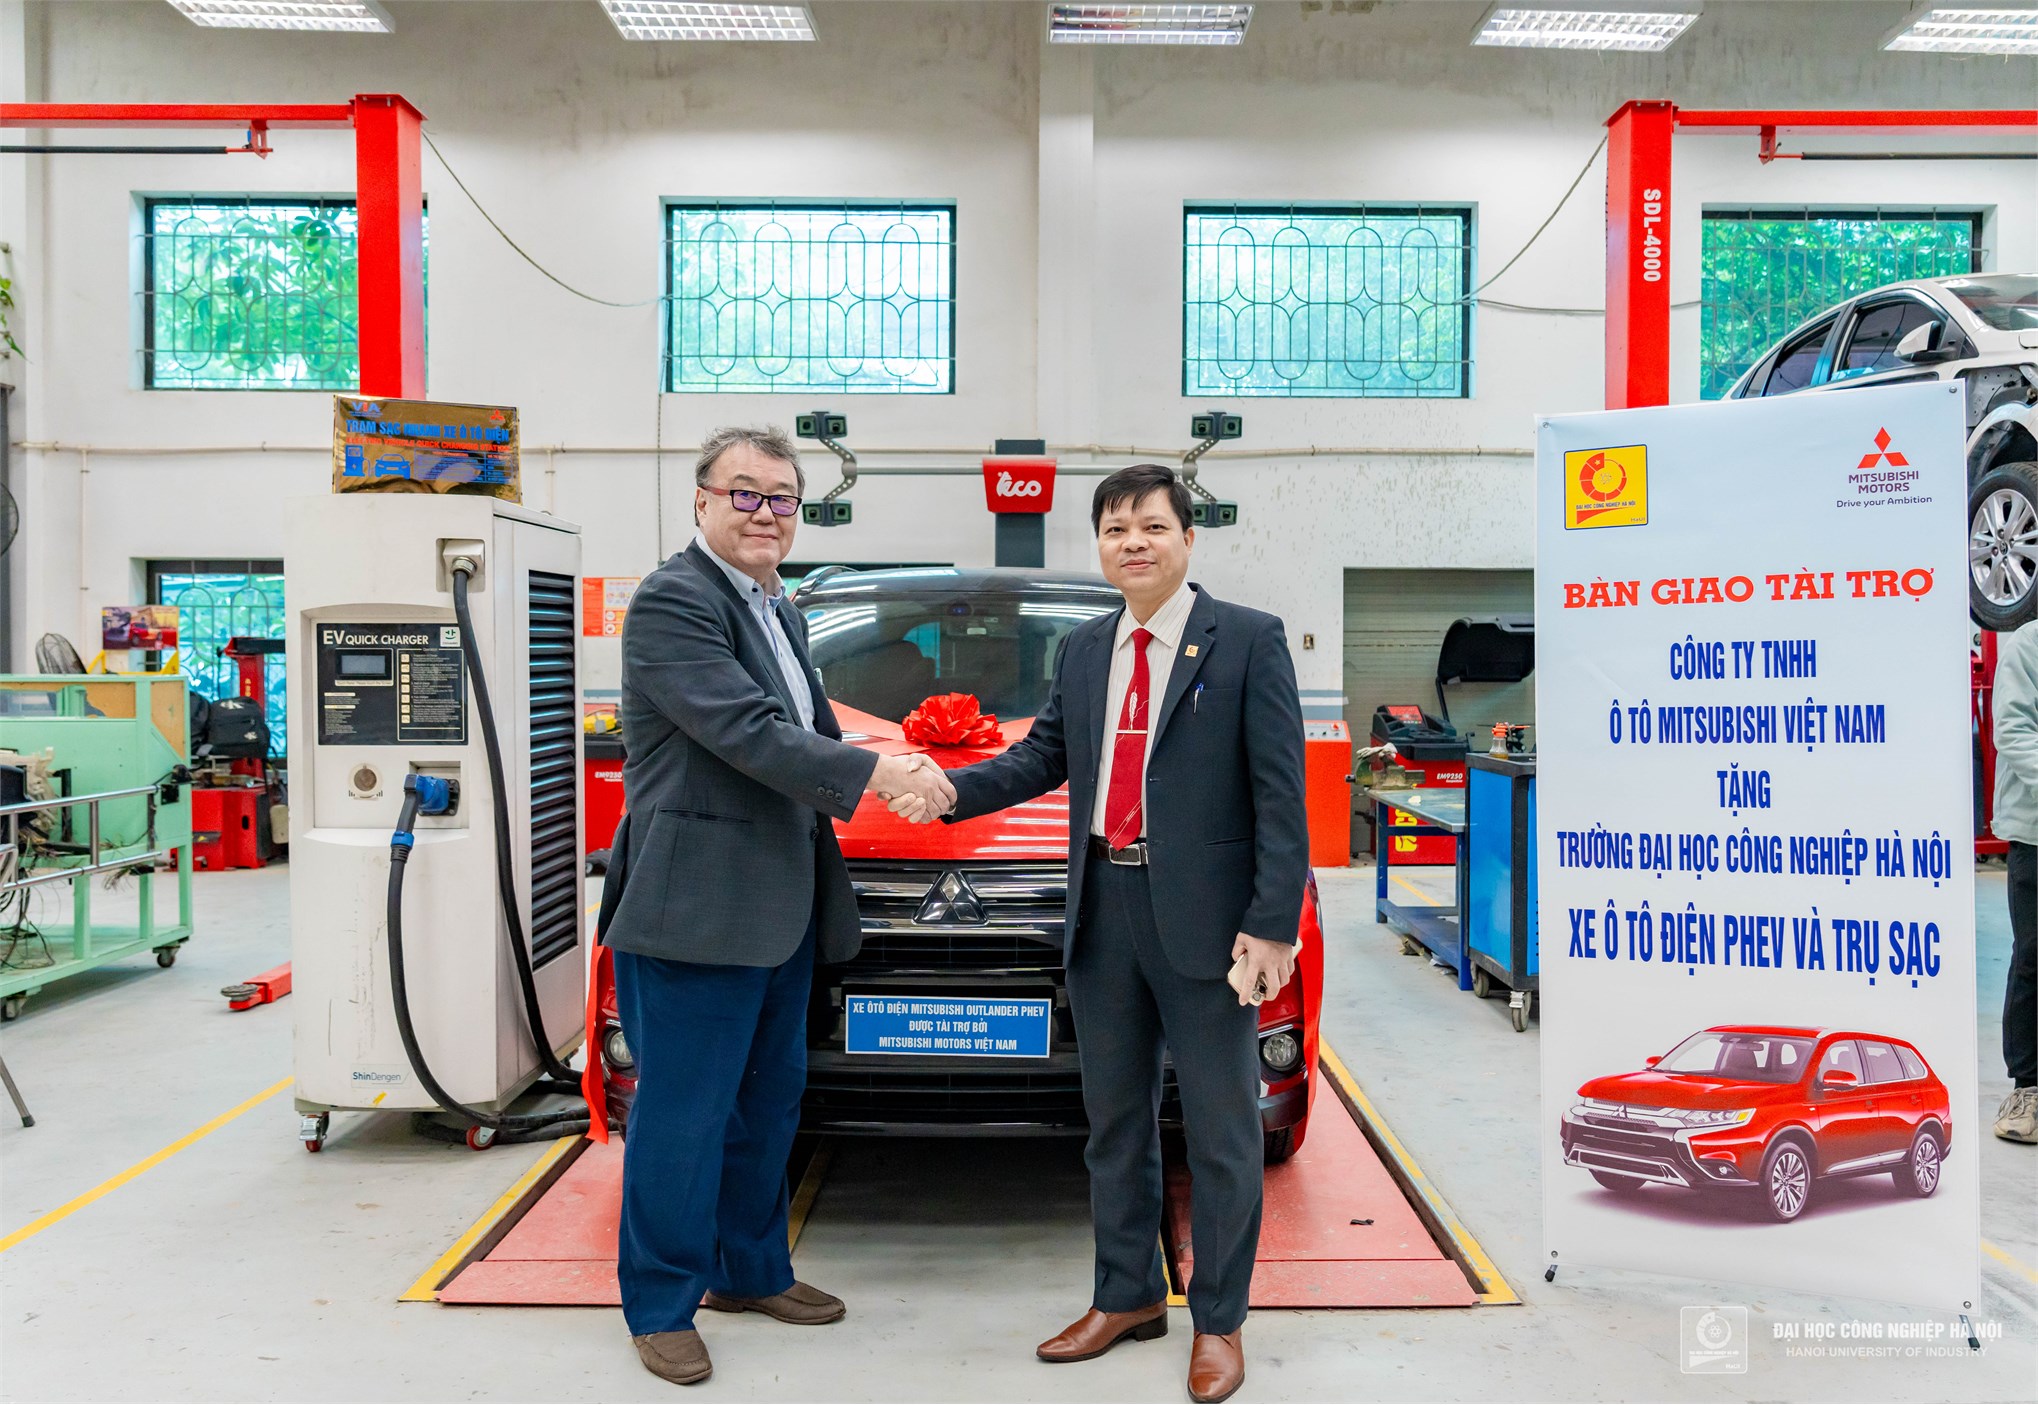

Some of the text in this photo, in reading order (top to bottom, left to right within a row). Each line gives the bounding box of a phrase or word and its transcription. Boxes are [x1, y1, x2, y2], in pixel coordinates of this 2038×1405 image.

[1643, 188, 1662, 282] SDL-4000
[444, 425, 457, 438] XE
[1848, 470, 1919, 484] MITSUBISHI
[1858, 482, 1910, 494] MOTORS
[1836, 496, 1932, 508] Drive your Ambition
[1563, 567, 1935, 609] BÀN GIAO TÀI TRỢ
[323, 630, 429, 645] EV QUICK CHARGER
[1670, 634, 1817, 681] CÔNG TY TNHH
[1609, 697, 1886, 752] Ô TÔ MITSUBISHI VIỆT NAM
[1436, 772, 1463, 780] EM9250
[1716, 762, 1771, 816] TẶNG
[1557, 822, 1951, 888] TRƯỜNG ĐẠI HỌC CÔNG NGHIỆP HÀ NỘI
[1568, 898, 1941, 988] XE Ô TÔ ĐIỆN PHEV VÀ TRỤ SẠC
[853, 1001, 1045, 1017] XE ÔTÔ ĐIỆN MITSUBISHI OUTLANDER PHEV
[909, 1017, 987, 1034] ĐƯỢC TÀI TRỢ BỞI
[879, 1036, 1017, 1051] MITSUBISHI MOTORS VIỆT NAM
[352, 1071, 401, 1083] ShinDengen
